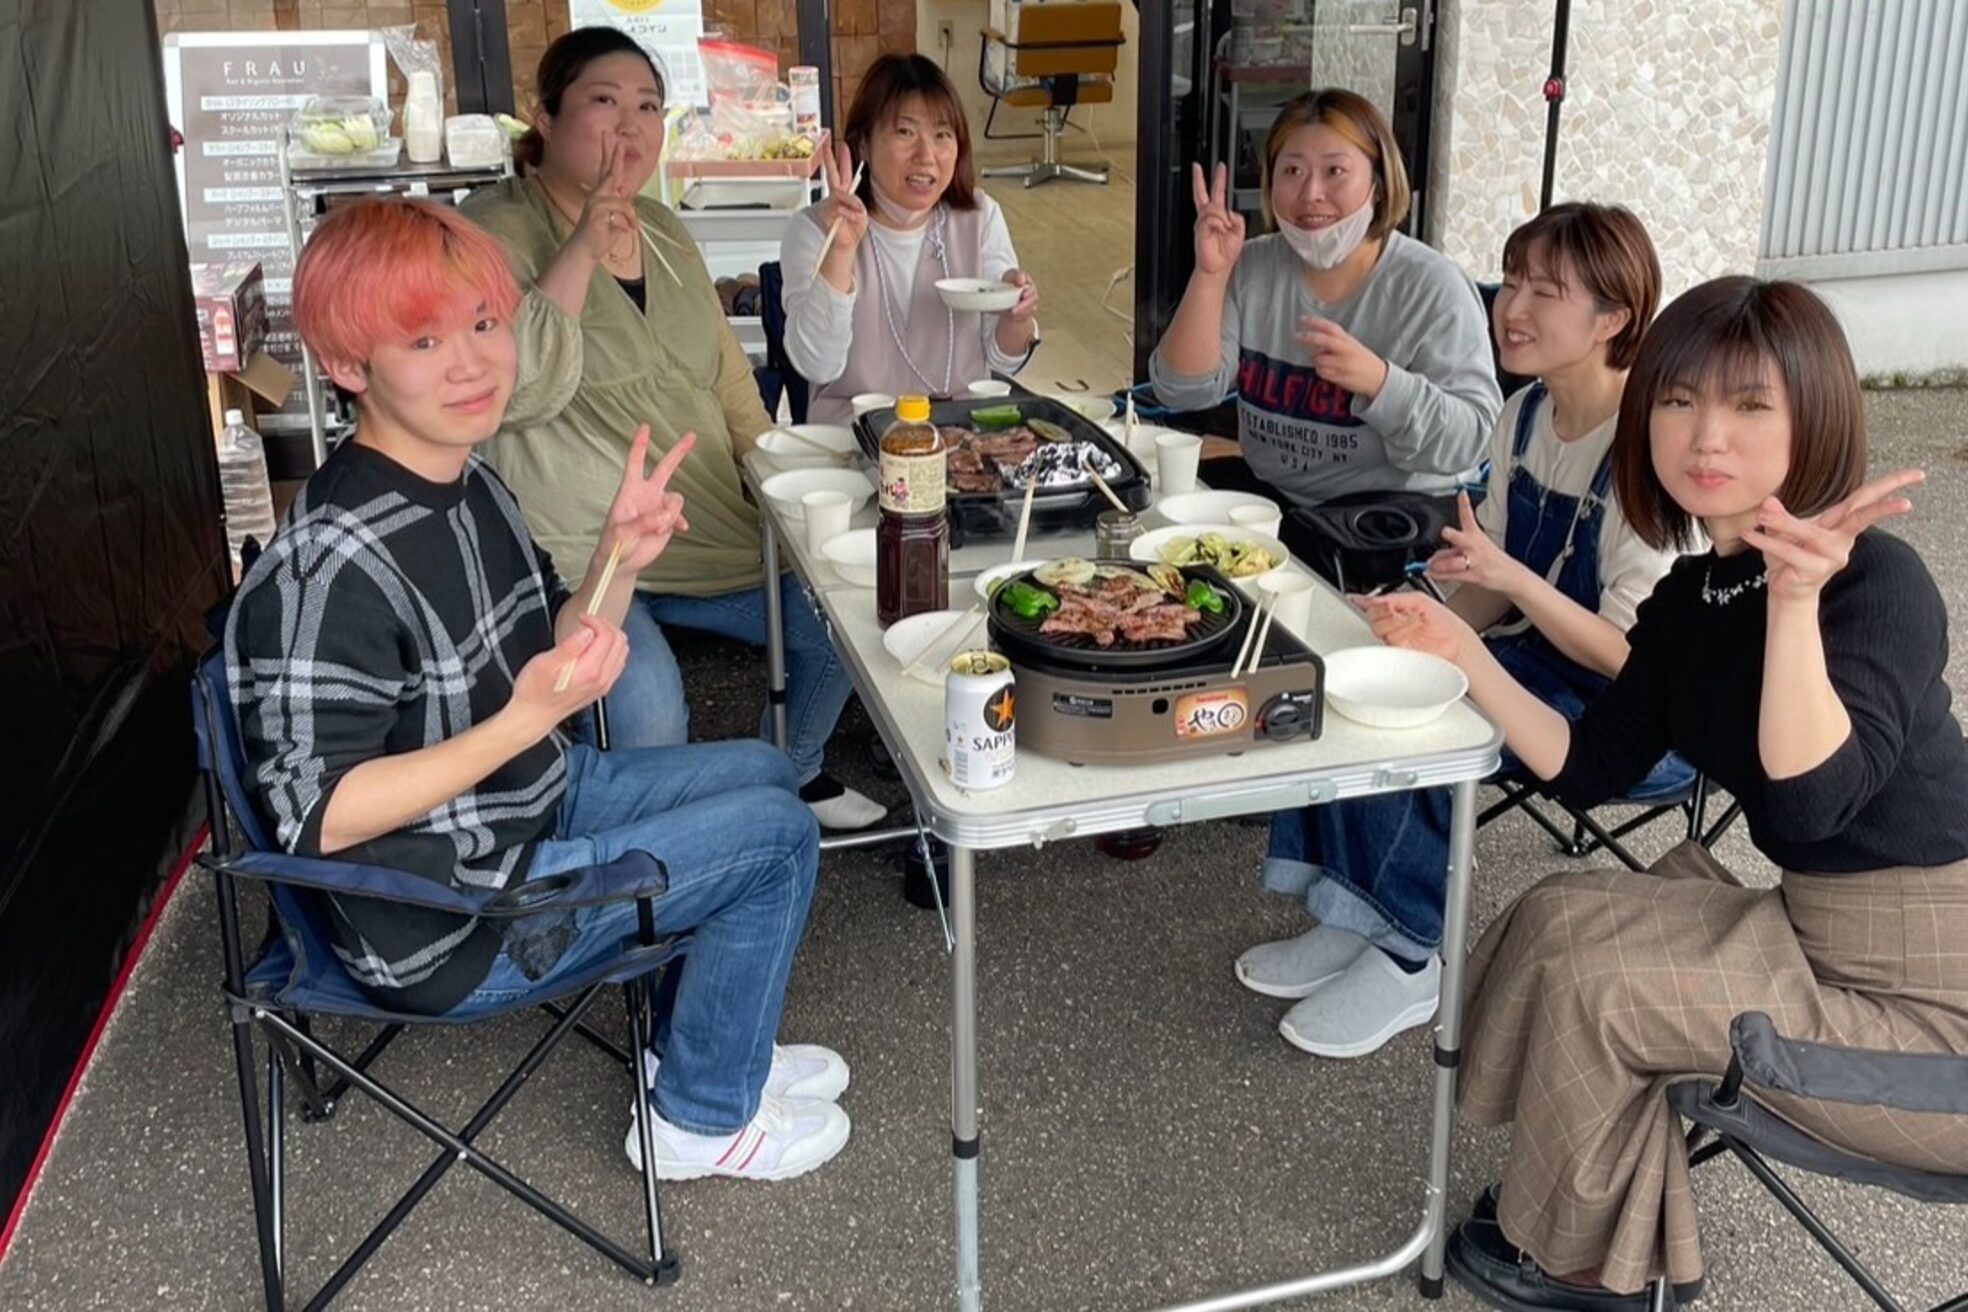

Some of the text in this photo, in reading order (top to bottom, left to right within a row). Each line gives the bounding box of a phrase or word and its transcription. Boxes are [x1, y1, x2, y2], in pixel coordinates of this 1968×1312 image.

[223, 60, 306, 77] FRAU
[221, 111, 280, 121] オリジナルカット
[1239, 358, 1348, 418] HILFIGE
[1241, 407, 1359, 450] ESTABLISHED 1985
